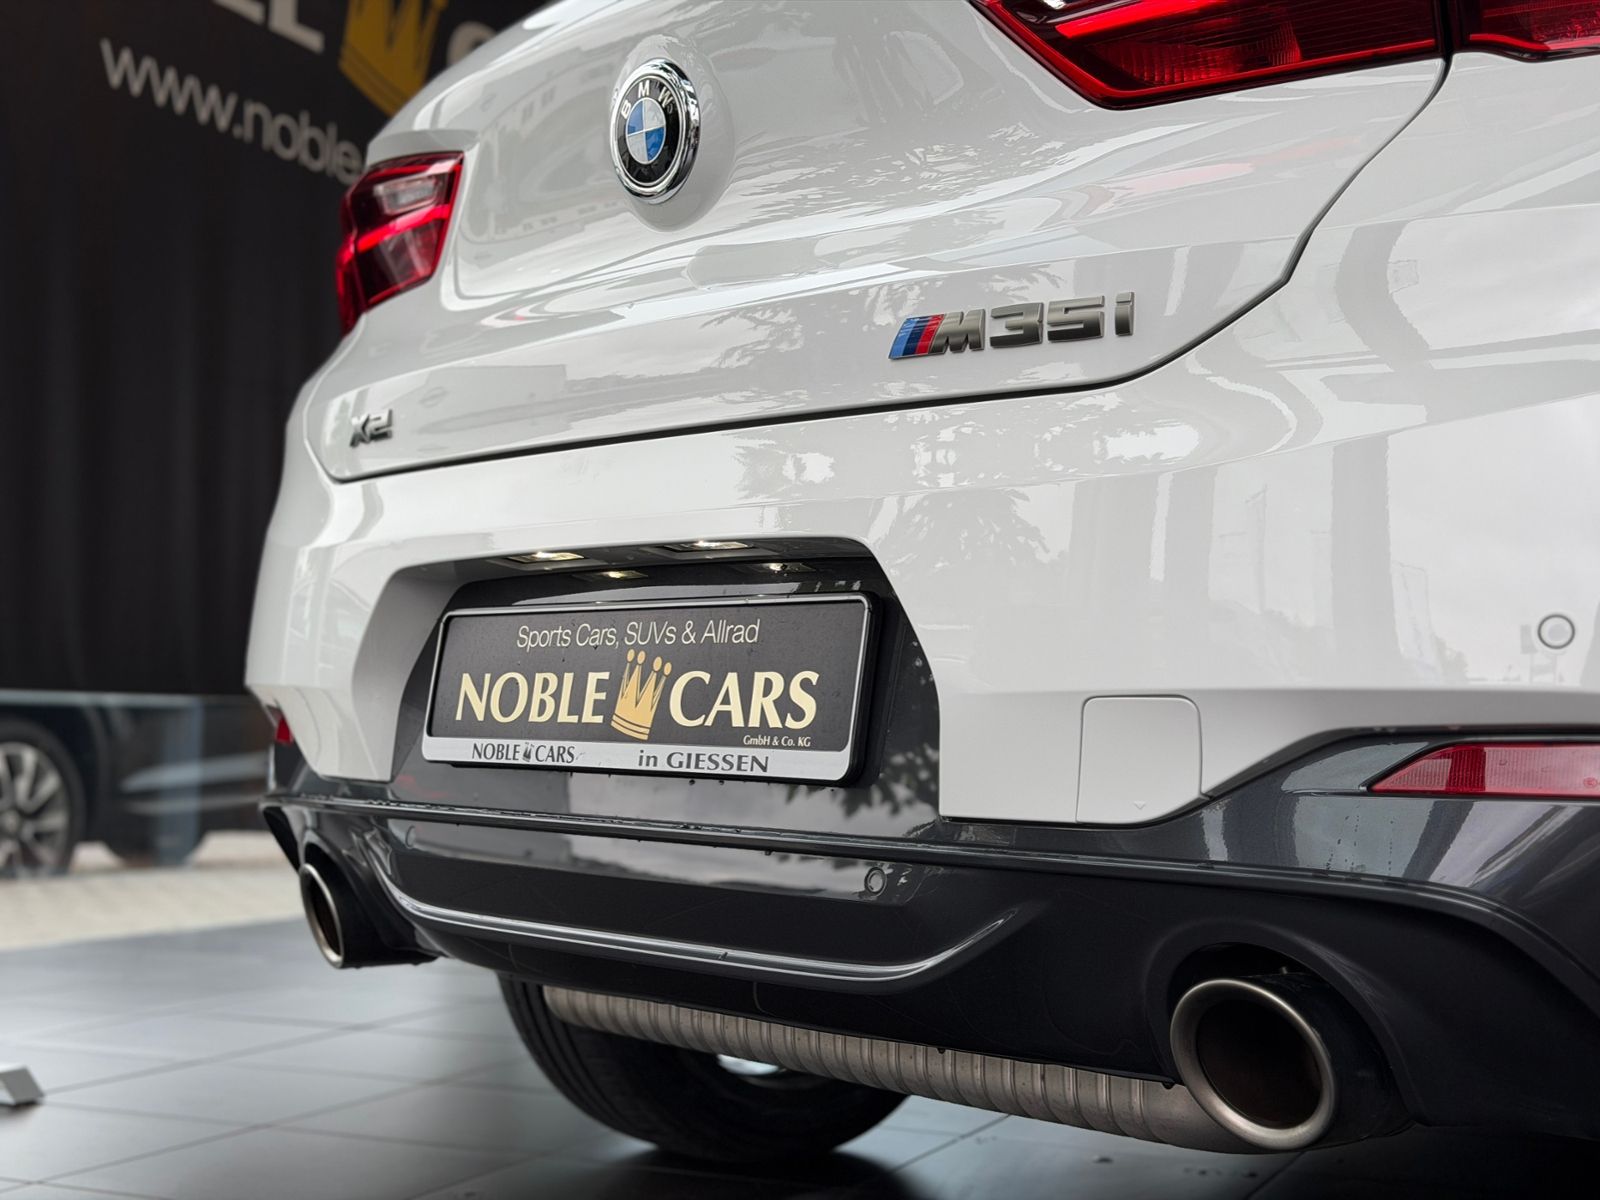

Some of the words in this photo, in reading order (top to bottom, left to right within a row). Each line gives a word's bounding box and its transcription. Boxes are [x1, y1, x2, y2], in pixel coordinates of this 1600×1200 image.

[620, 79, 674, 119] BMW
[928, 291, 1135, 354] M35i
[349, 408, 393, 448] X2
[516, 625, 572, 653] Sports
[575, 623, 619, 649] Cars,
[624, 621, 677, 645] SUVs
[681, 620, 697, 644] &
[700, 618, 760, 643] Allrad
[455, 671, 610, 723] NOBLE
[669, 670, 820, 730] CARS
[471, 742, 521, 761] NOBLE
[535, 744, 575, 764] CARS
[742, 734, 771, 746] GmbH
[771, 736, 780, 746] &
[781, 736, 796, 747] Co.
[797, 736, 811, 747] KG
[638, 750, 659, 767] in
[666, 751, 769, 773] GIESSEN
